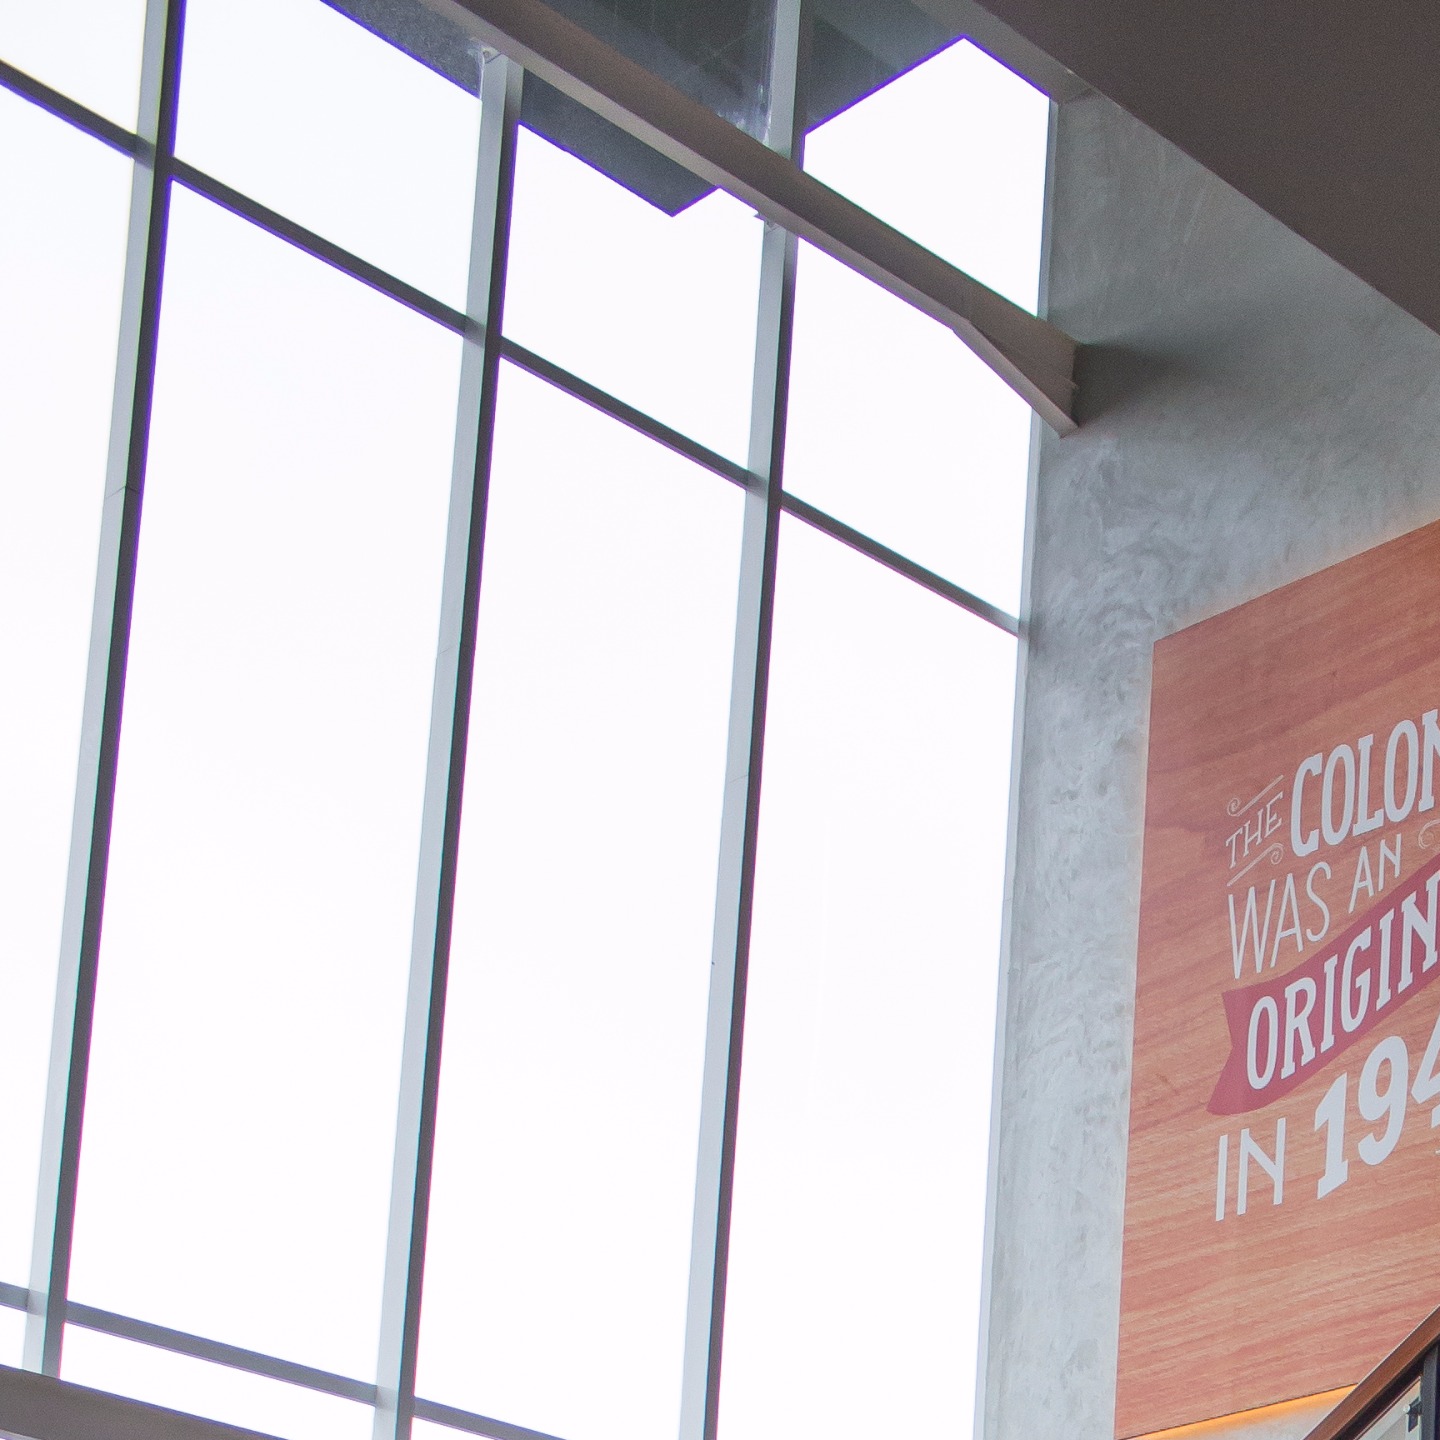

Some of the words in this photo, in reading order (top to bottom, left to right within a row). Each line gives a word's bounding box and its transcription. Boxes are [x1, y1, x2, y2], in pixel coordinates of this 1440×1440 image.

[1225, 793, 1283, 868] THE
[1228, 860, 1330, 979] WAS
[1348, 833, 1402, 912] AN
[1215, 1117, 1287, 1221] IN
